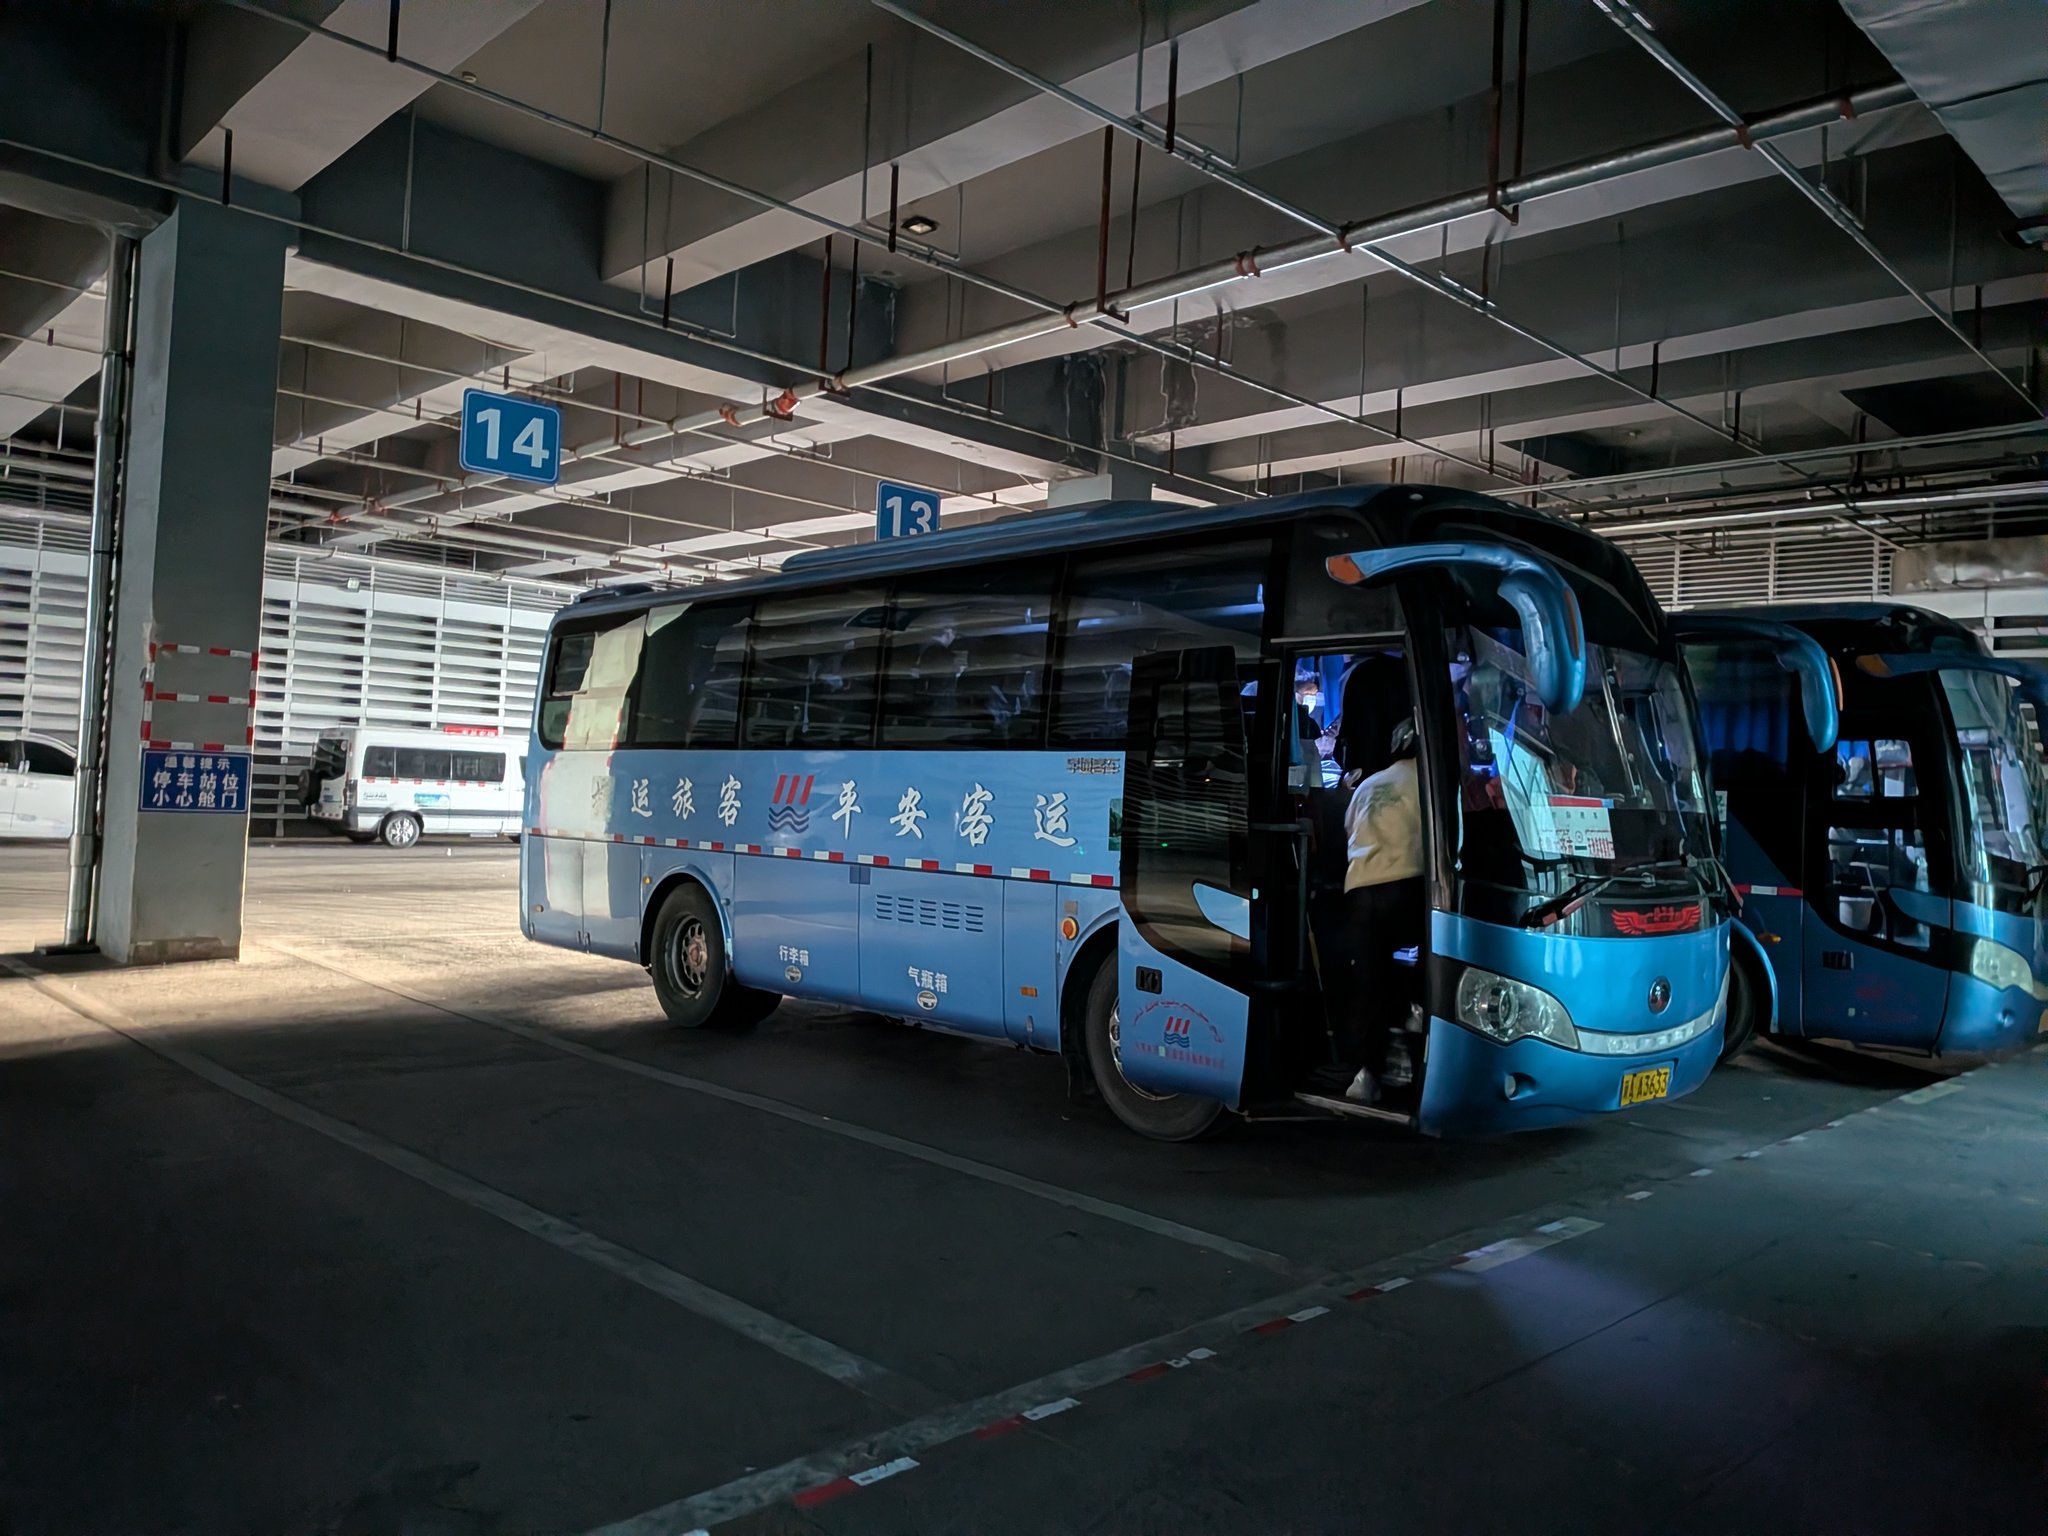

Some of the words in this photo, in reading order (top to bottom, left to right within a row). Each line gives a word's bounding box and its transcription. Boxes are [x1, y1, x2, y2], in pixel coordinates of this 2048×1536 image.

[476, 408, 550, 468] 14
[886, 496, 932, 537] 13
[152, 769, 239, 792] 停车站位
[152, 789, 238, 808] 小心舱门
[831, 779, 1078, 847] 平安客运
[778, 945, 810, 967] 行李箱
[907, 966, 949, 994] 气瓶箱
